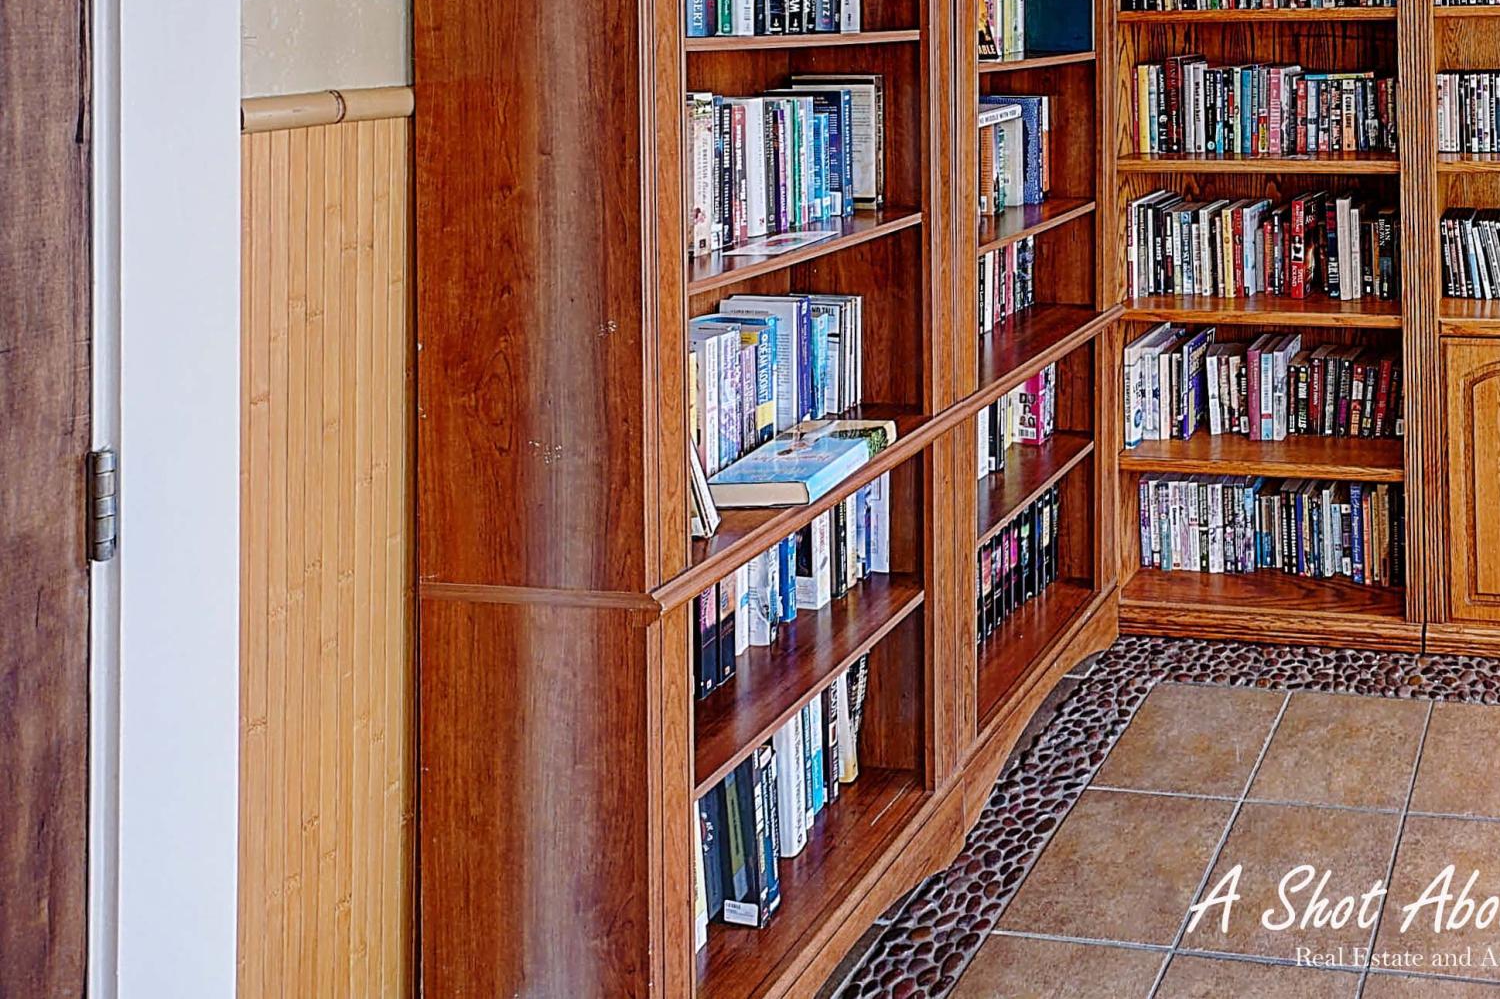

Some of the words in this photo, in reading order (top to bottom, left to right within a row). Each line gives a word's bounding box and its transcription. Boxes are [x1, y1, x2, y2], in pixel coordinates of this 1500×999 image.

[758, 343, 767, 367] DEAN
[758, 368, 767, 404] KOONTZ
[1298, 382, 1307, 399] WAR
